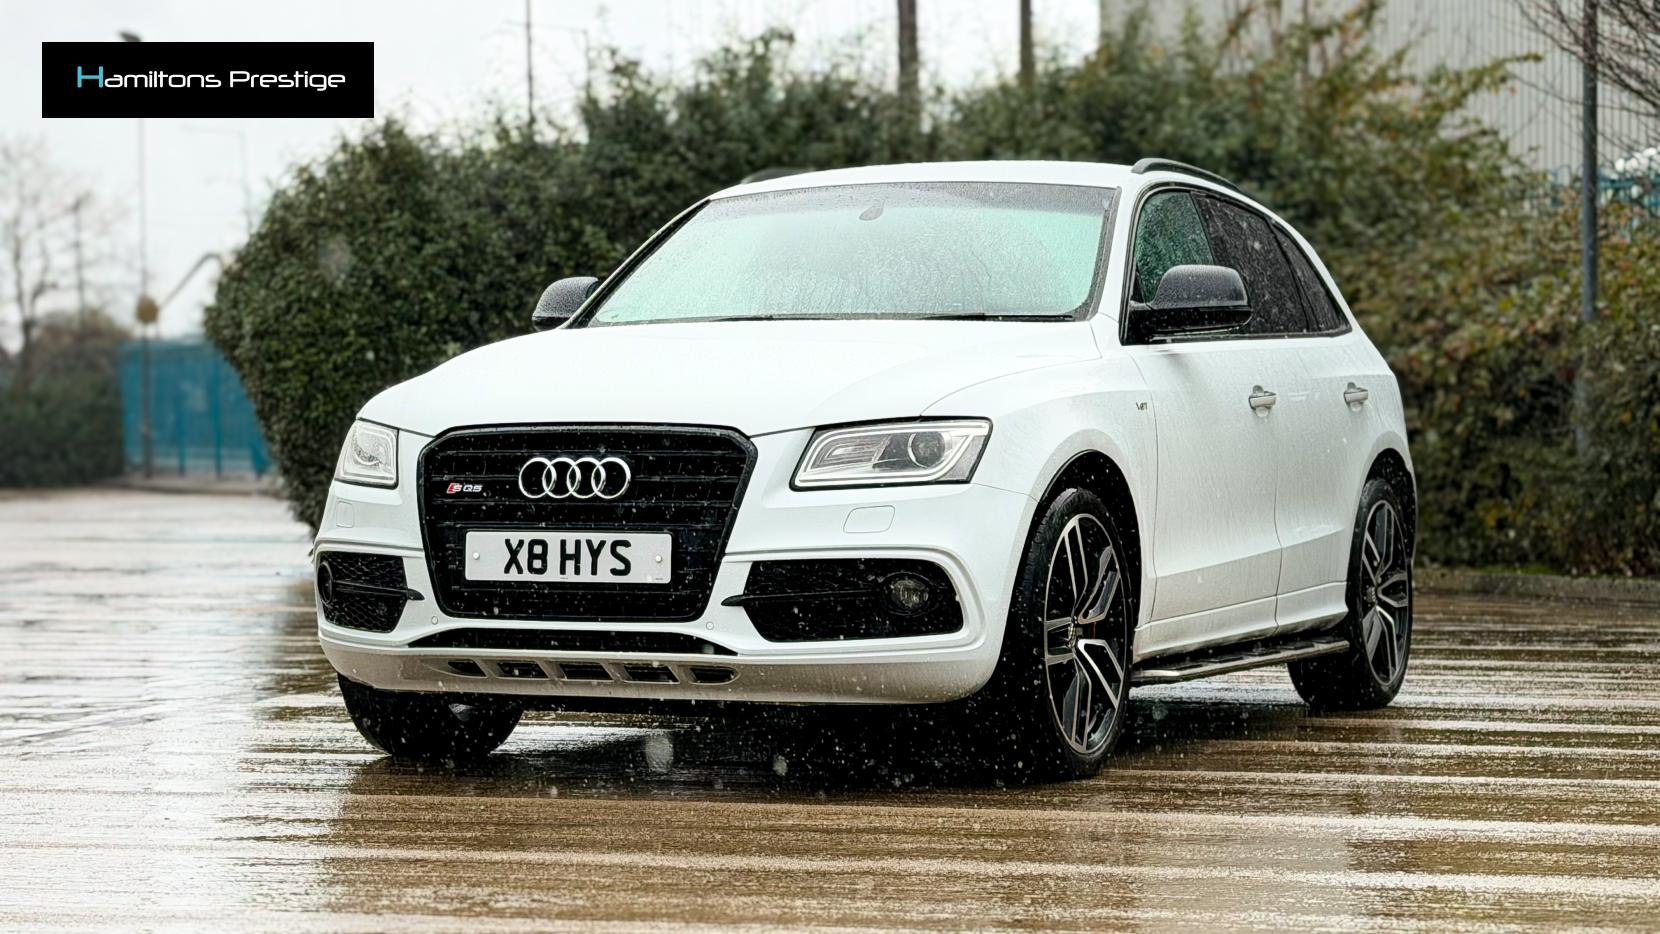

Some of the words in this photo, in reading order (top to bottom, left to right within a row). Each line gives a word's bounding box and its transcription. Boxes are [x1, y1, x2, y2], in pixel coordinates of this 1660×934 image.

[446, 482, 484, 494] SQ5
[503, 538, 549, 575] X8
[559, 539, 632, 577] HYS
